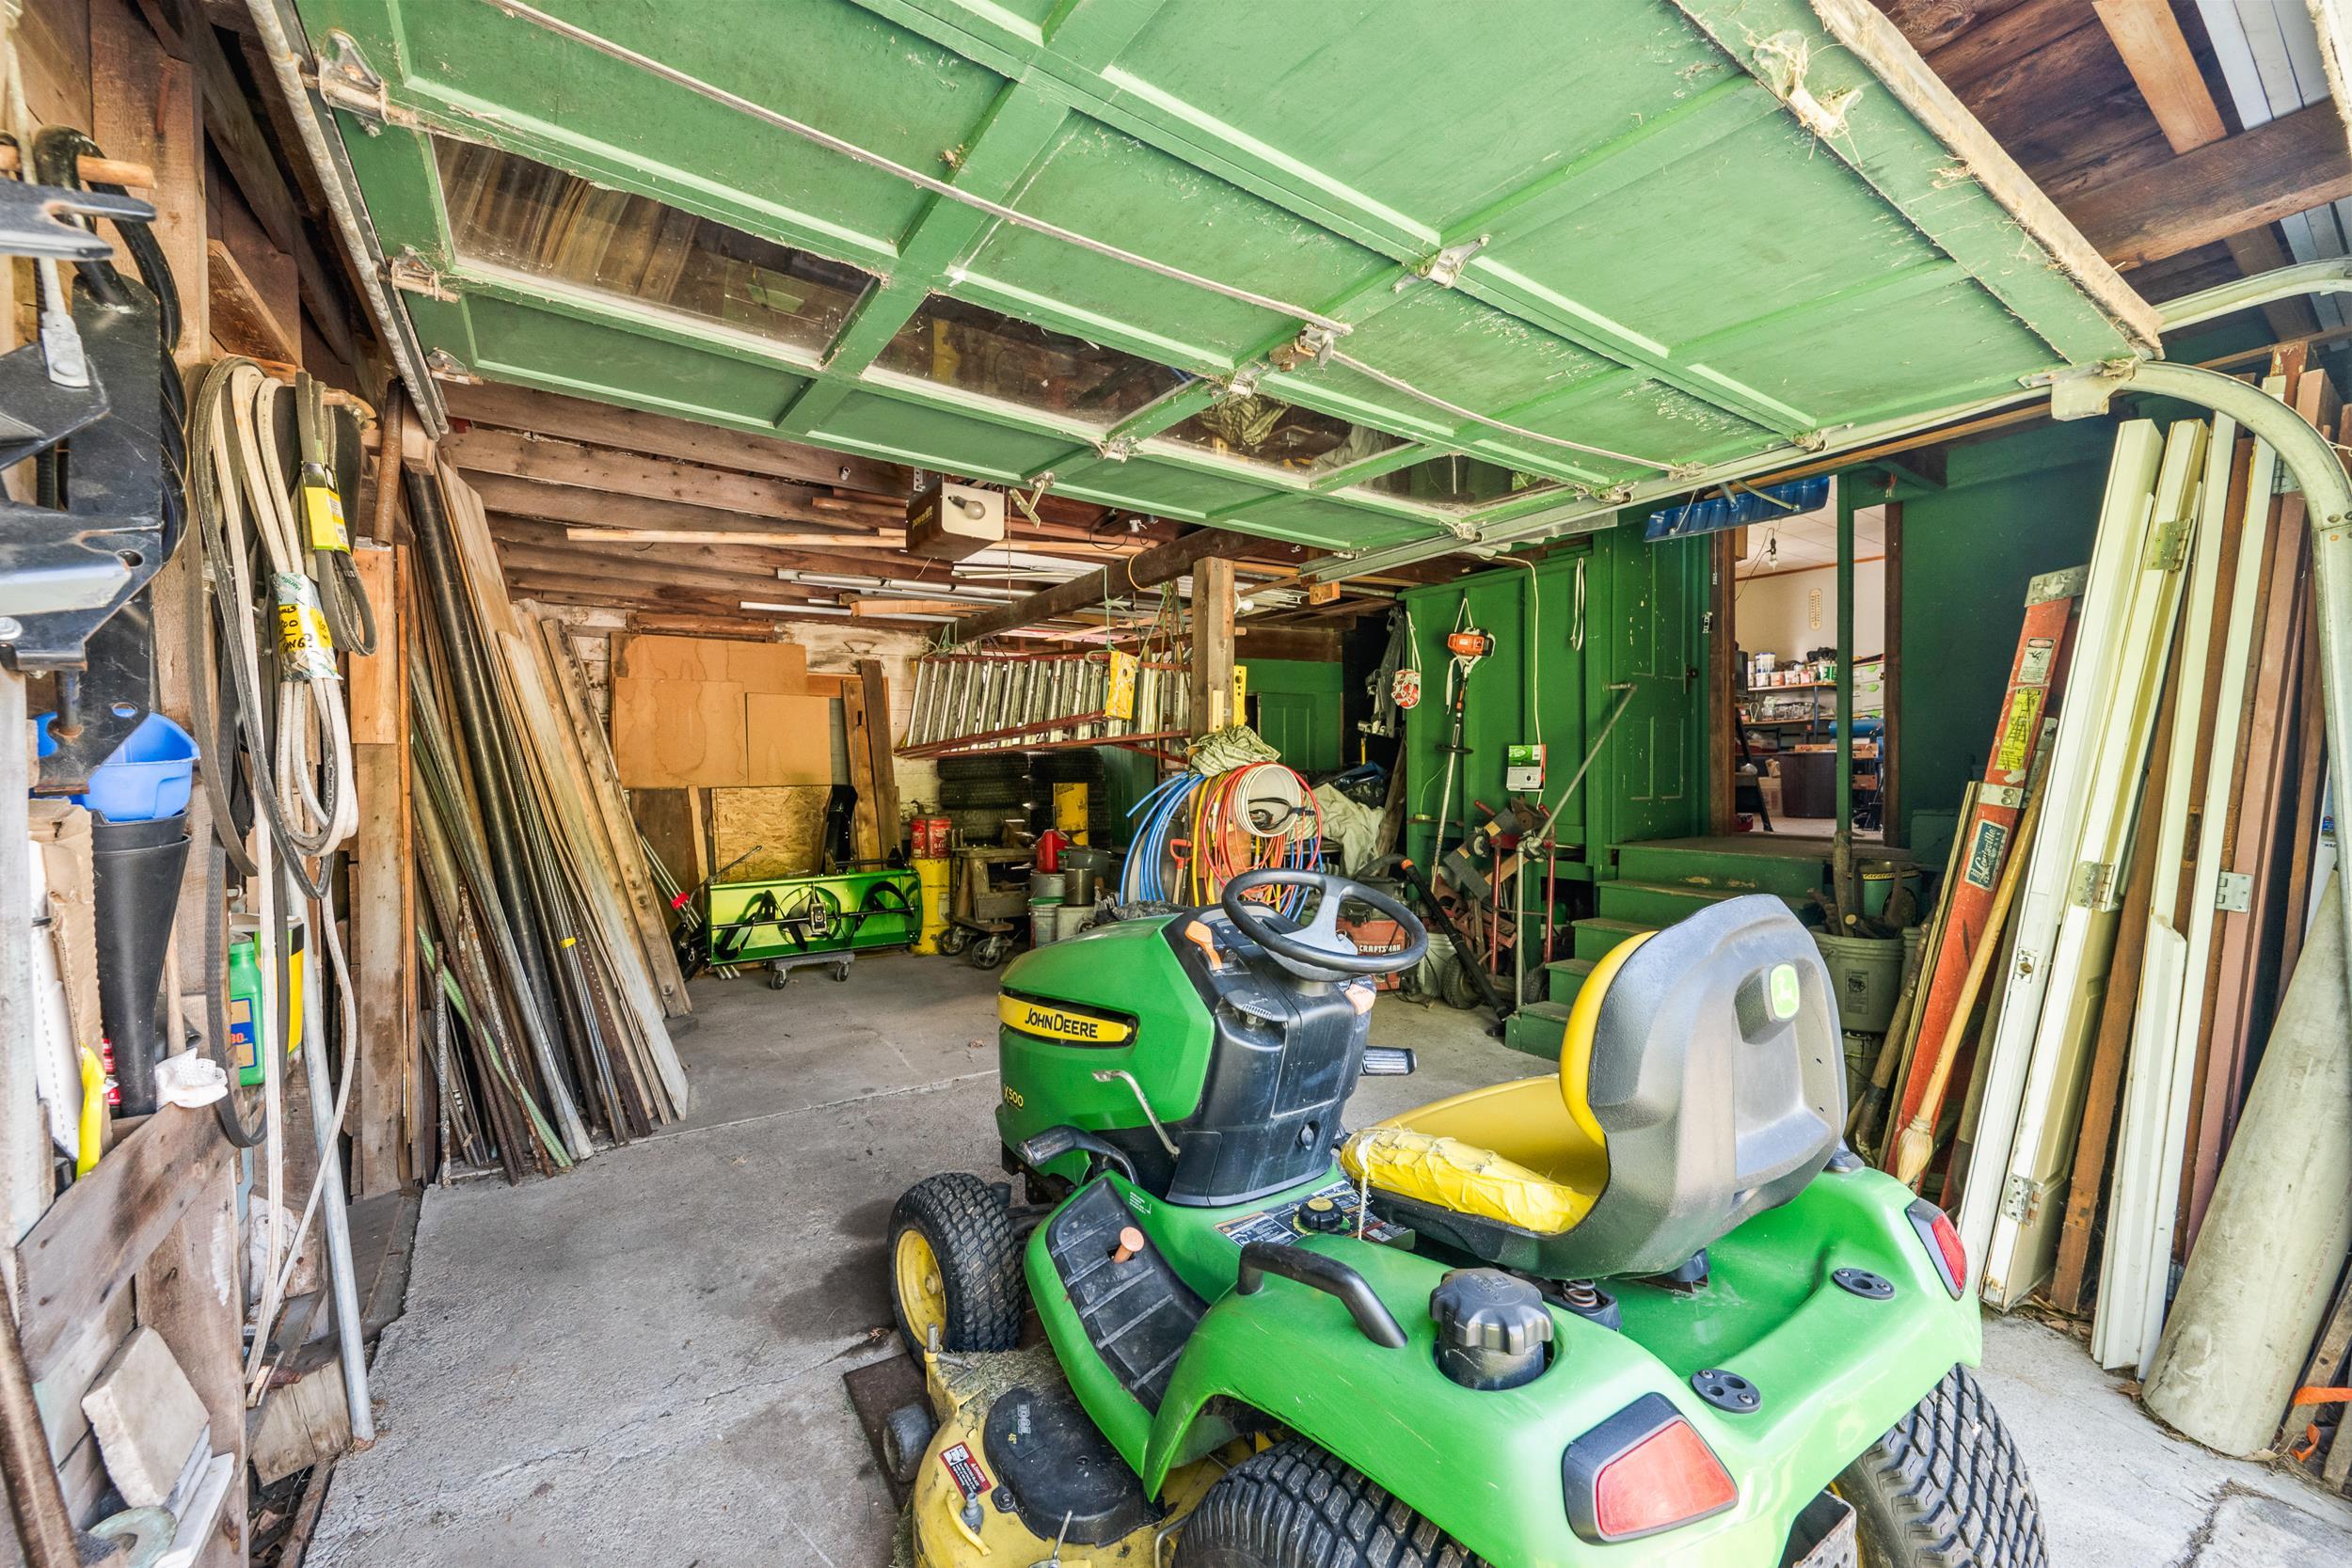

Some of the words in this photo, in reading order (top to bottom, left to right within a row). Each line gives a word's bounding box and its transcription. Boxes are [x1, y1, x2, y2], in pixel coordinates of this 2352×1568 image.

[1025, 1008, 1053, 1030] JOHN
[1054, 1014, 1098, 1038] DEERE
[1004, 1085, 1024, 1107] X500
